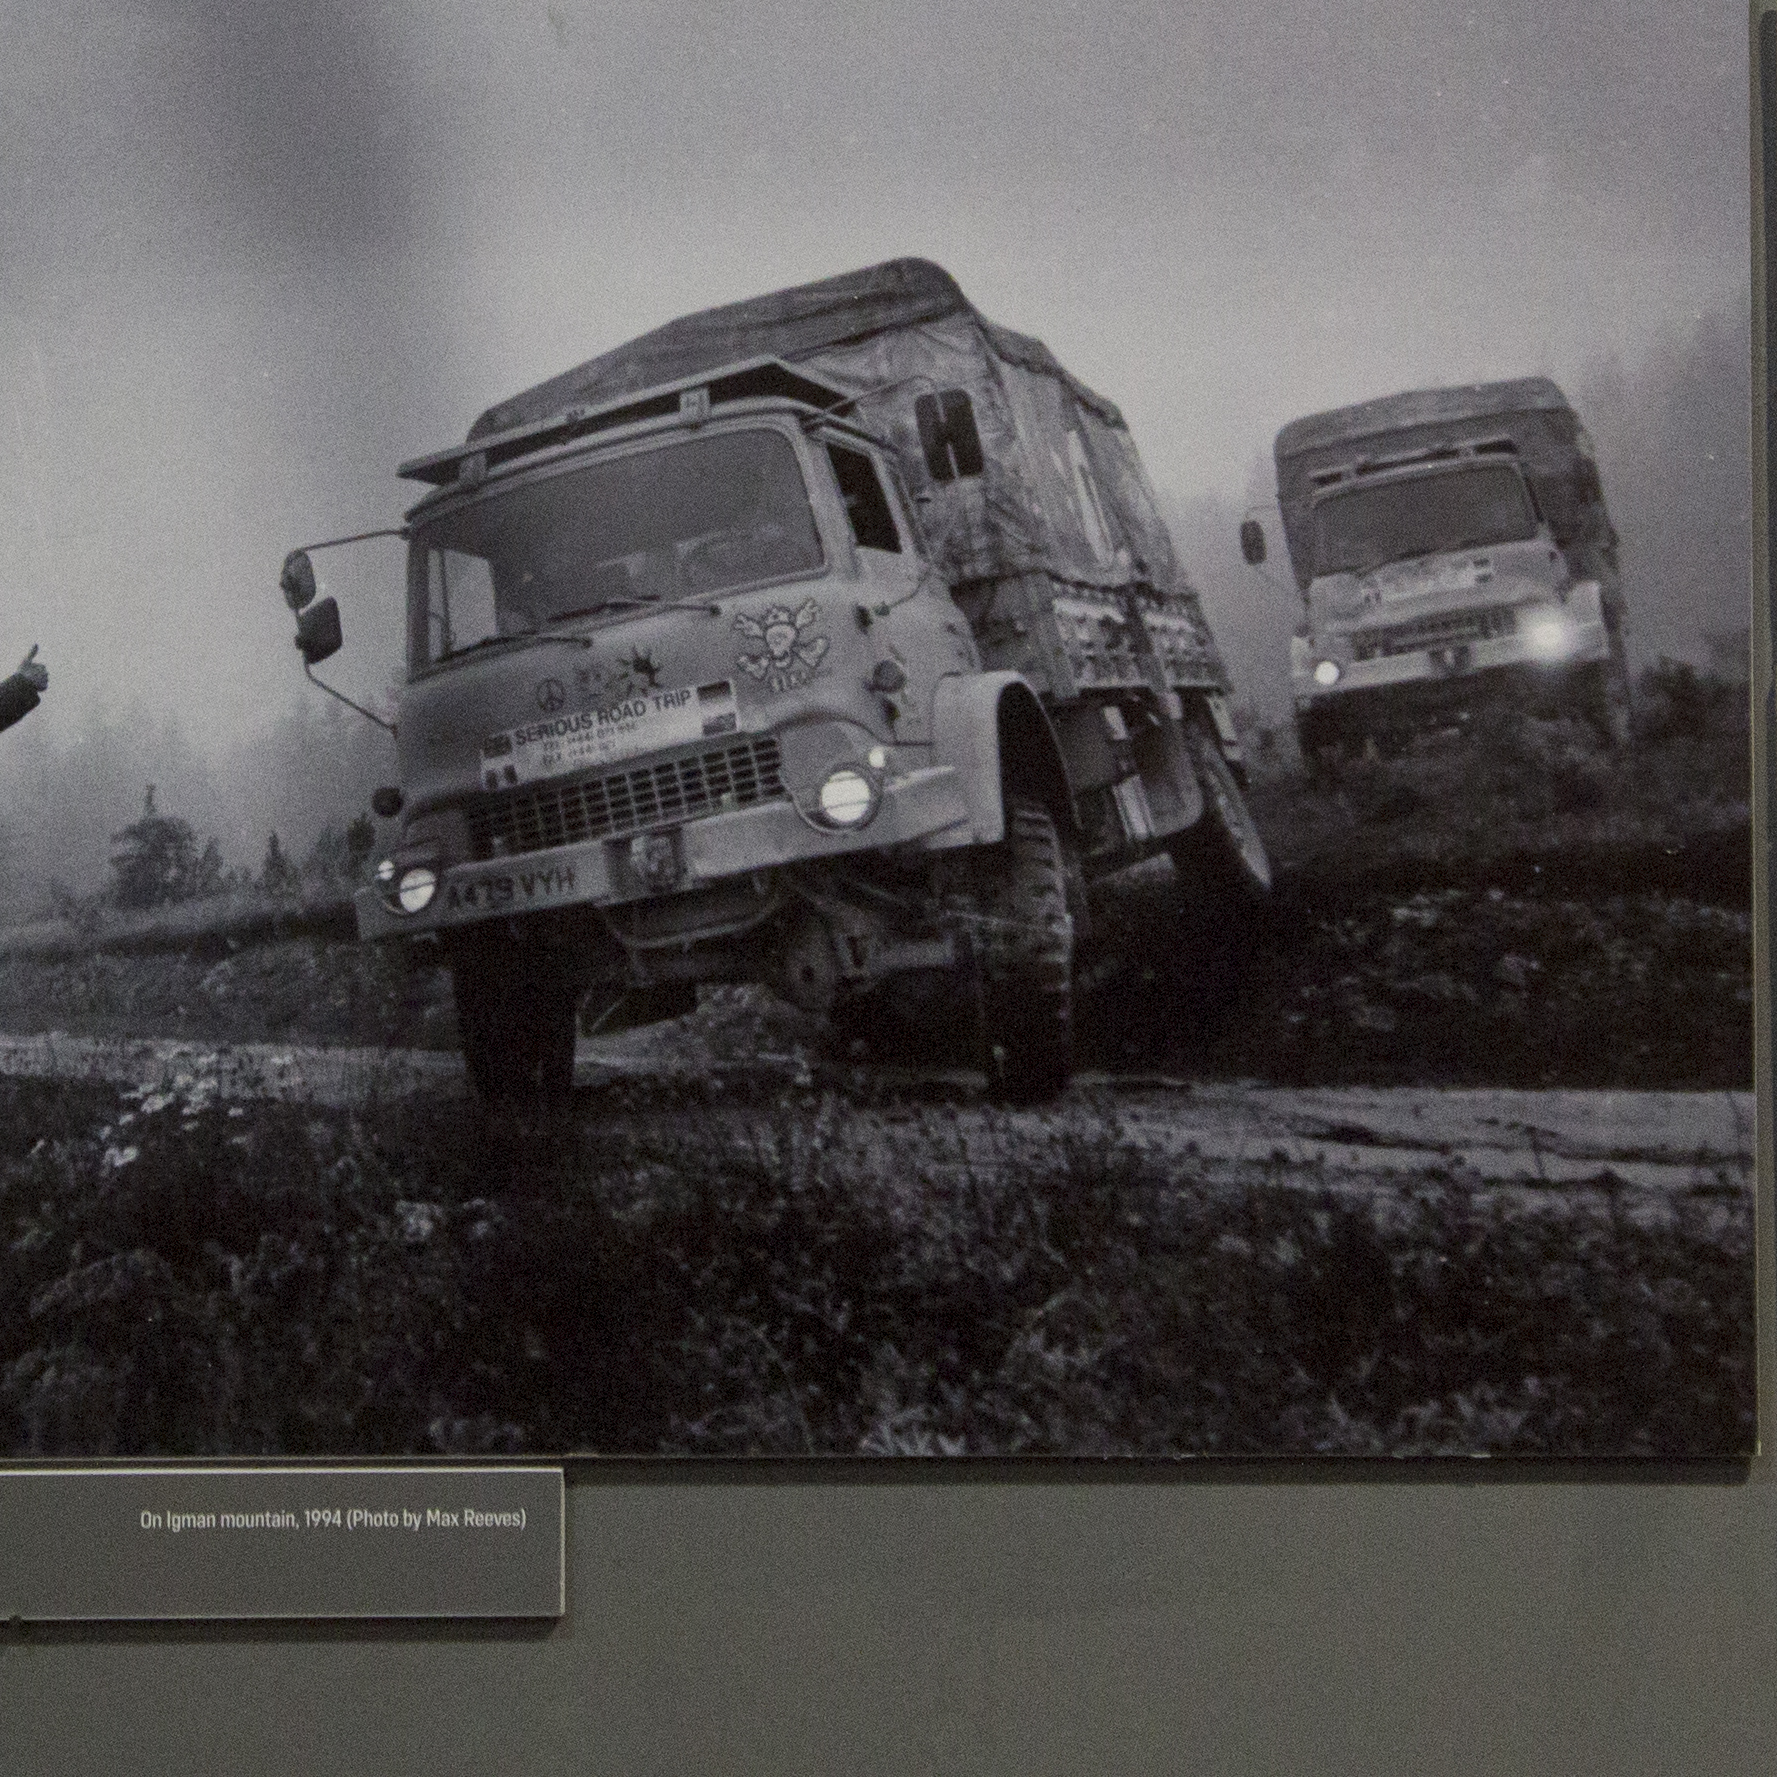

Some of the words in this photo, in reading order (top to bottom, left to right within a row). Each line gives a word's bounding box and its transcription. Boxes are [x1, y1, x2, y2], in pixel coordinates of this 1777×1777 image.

[514, 712, 593, 747] SERIOUS
[596, 699, 647, 727] ROAD
[652, 687, 693, 712] TRIP
